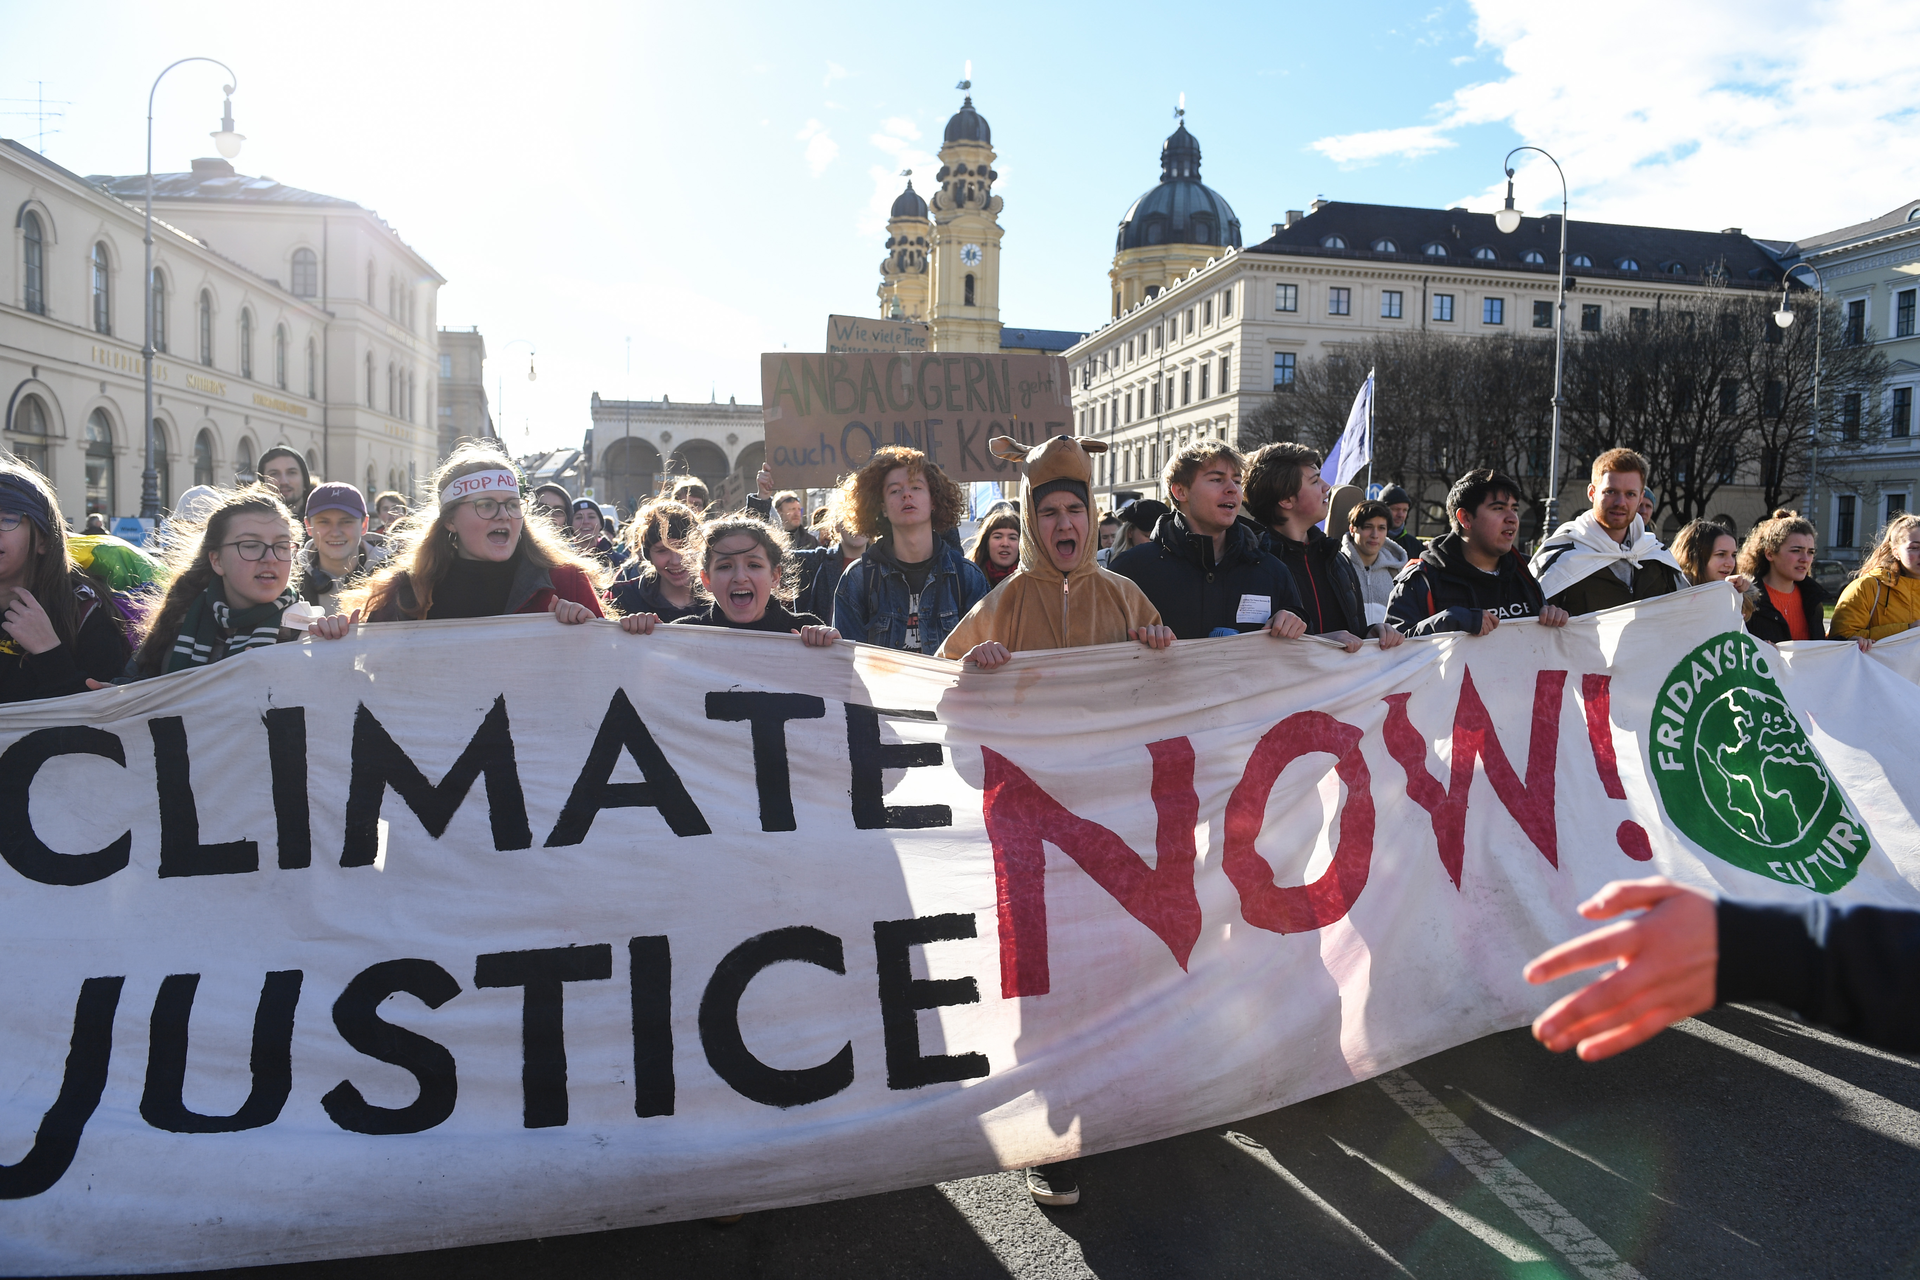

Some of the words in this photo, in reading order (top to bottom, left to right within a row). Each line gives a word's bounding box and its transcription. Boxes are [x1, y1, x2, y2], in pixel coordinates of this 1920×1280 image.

[834, 319, 867, 341] Wie
[872, 327, 901, 344] viele
[899, 327, 926, 348] Tiere
[772, 356, 1012, 416] ANBAGGERN
[1018, 371, 1055, 410] geht
[453, 475, 492, 497] STOP
[773, 432, 837, 468] auch
[1657, 639, 1737, 772] FRIDAYS
[0, 687, 952, 887] CLIMATE
[980, 663, 1654, 1000] NOW!
[0, 913, 991, 1199] JUSTICE
